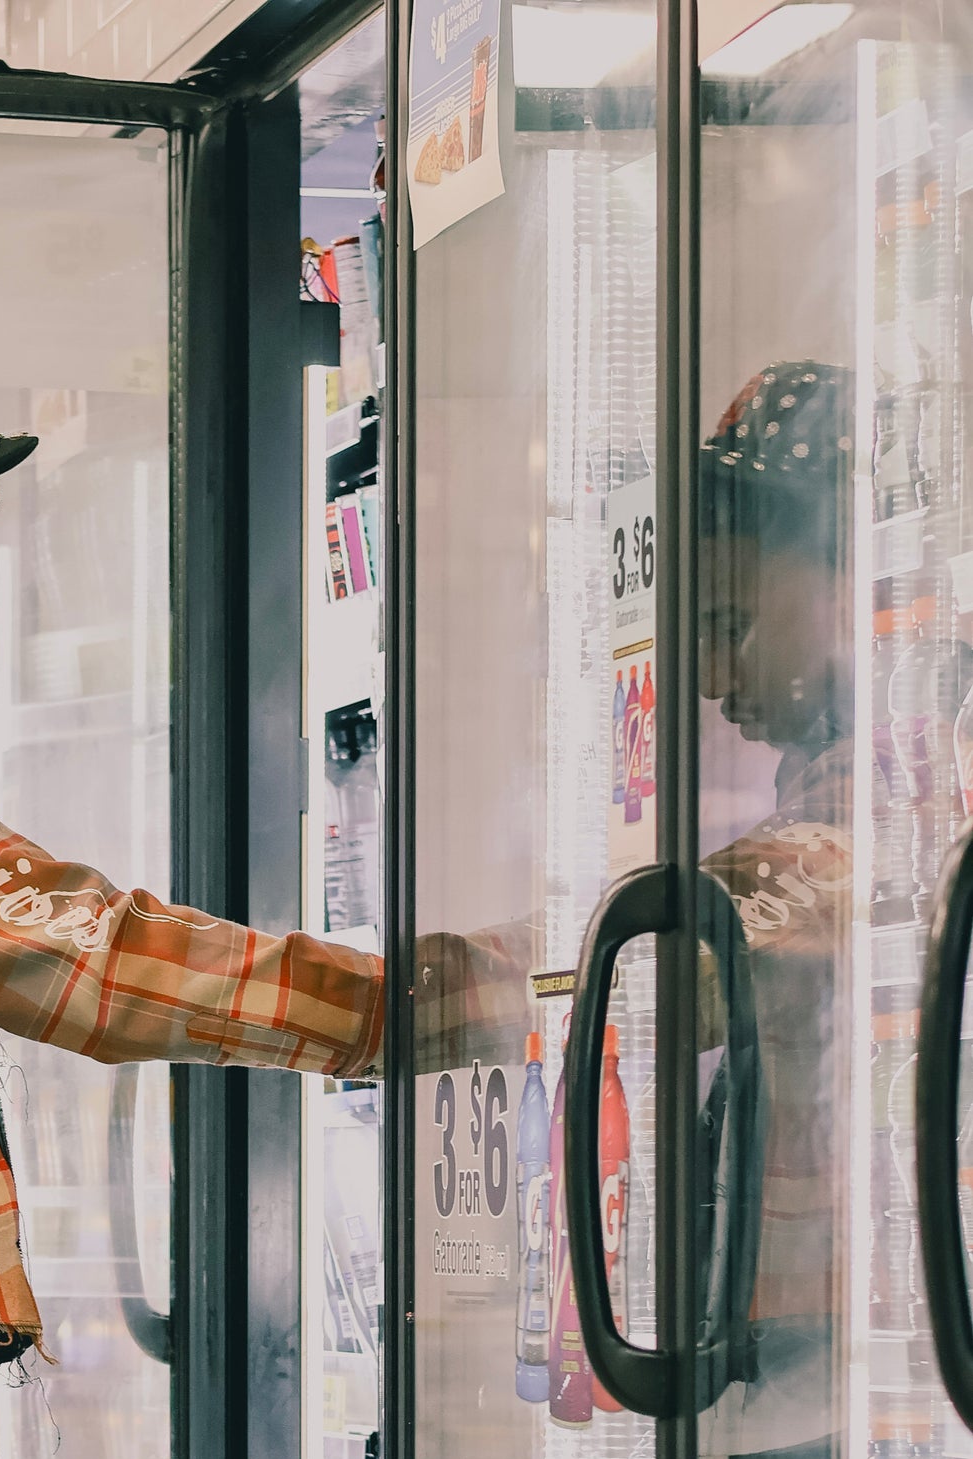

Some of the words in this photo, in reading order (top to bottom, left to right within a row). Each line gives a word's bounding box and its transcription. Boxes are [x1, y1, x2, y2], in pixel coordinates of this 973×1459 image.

[613, 527, 625, 599] 3
[627, 571, 639, 595] FOR
[433, 1069, 457, 1219] 3
[458, 1168, 481, 1217] FOR
[600, 1173, 620, 1254] G
[433, 1228, 481, 1276] Gatorade
